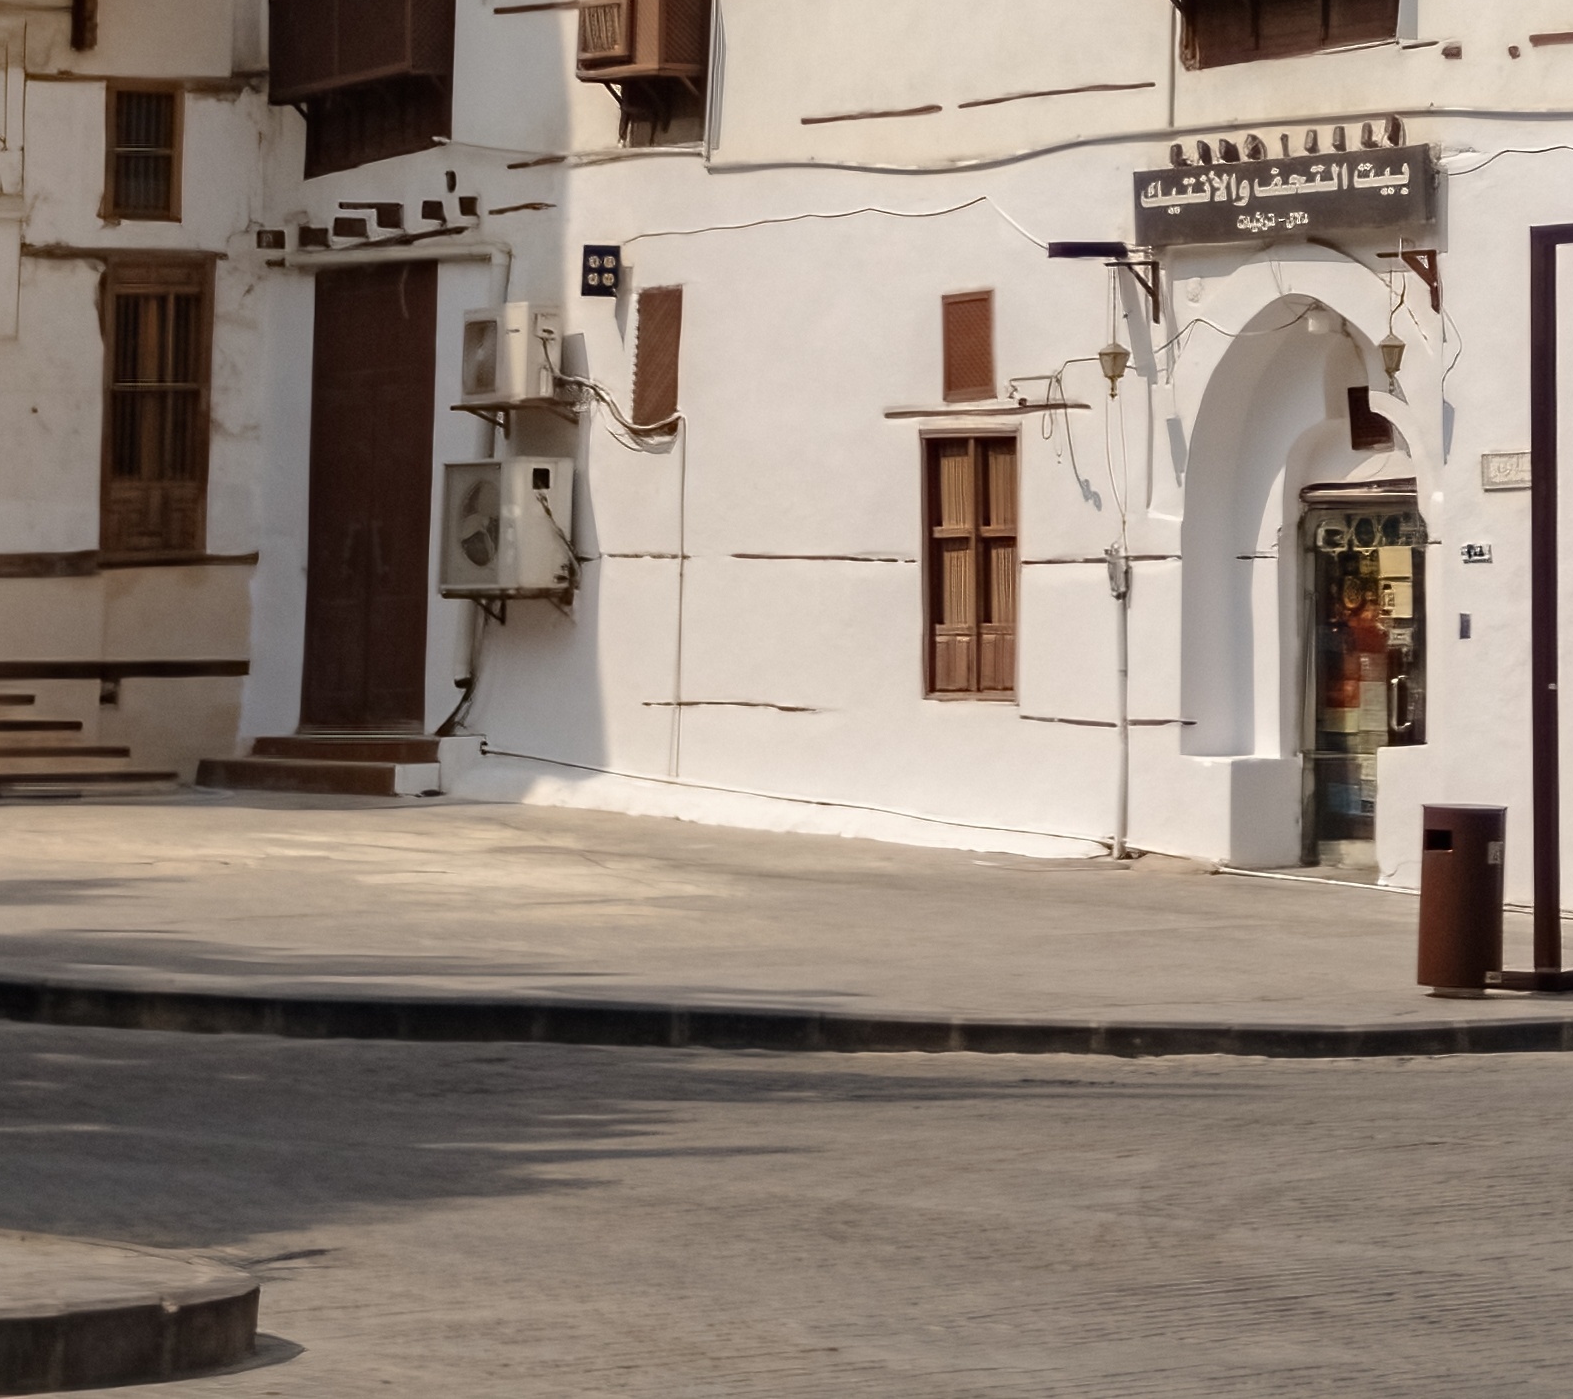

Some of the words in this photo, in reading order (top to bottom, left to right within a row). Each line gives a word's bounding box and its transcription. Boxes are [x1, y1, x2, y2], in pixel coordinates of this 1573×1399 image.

[1140, 170, 1251, 215] والأنتيك
[1253, 161, 1349, 198] التحف
[1354, 162, 1410, 196] بيت
